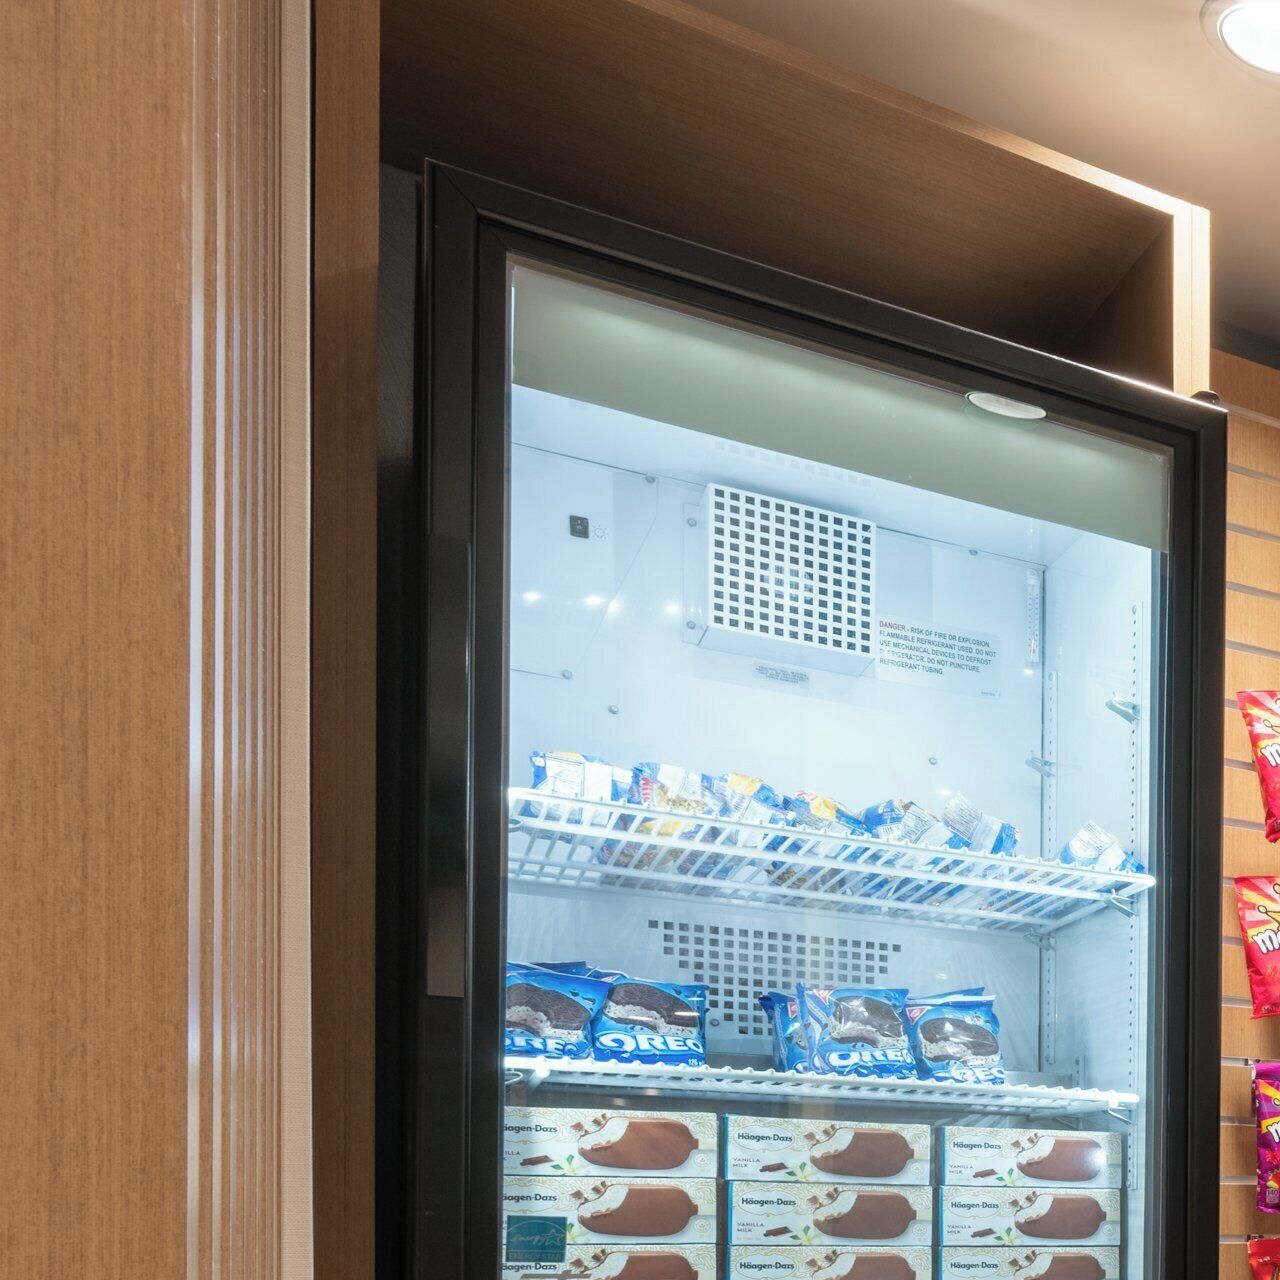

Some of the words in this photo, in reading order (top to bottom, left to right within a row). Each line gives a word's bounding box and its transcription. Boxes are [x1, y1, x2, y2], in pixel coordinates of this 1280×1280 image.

[879, 620, 906, 632] DANGER
[737, 1131, 793, 1144] Häagen-Dazs
[952, 1141, 1002, 1153] Häagen-Dazs
[741, 1196, 797, 1208] Häagen-Dazs
[950, 1201, 1000, 1212] Häagen-Dazs
[739, 1260, 795, 1273] Häagen-Dazs
[950, 1261, 999, 1272] Häagen-Dazs
